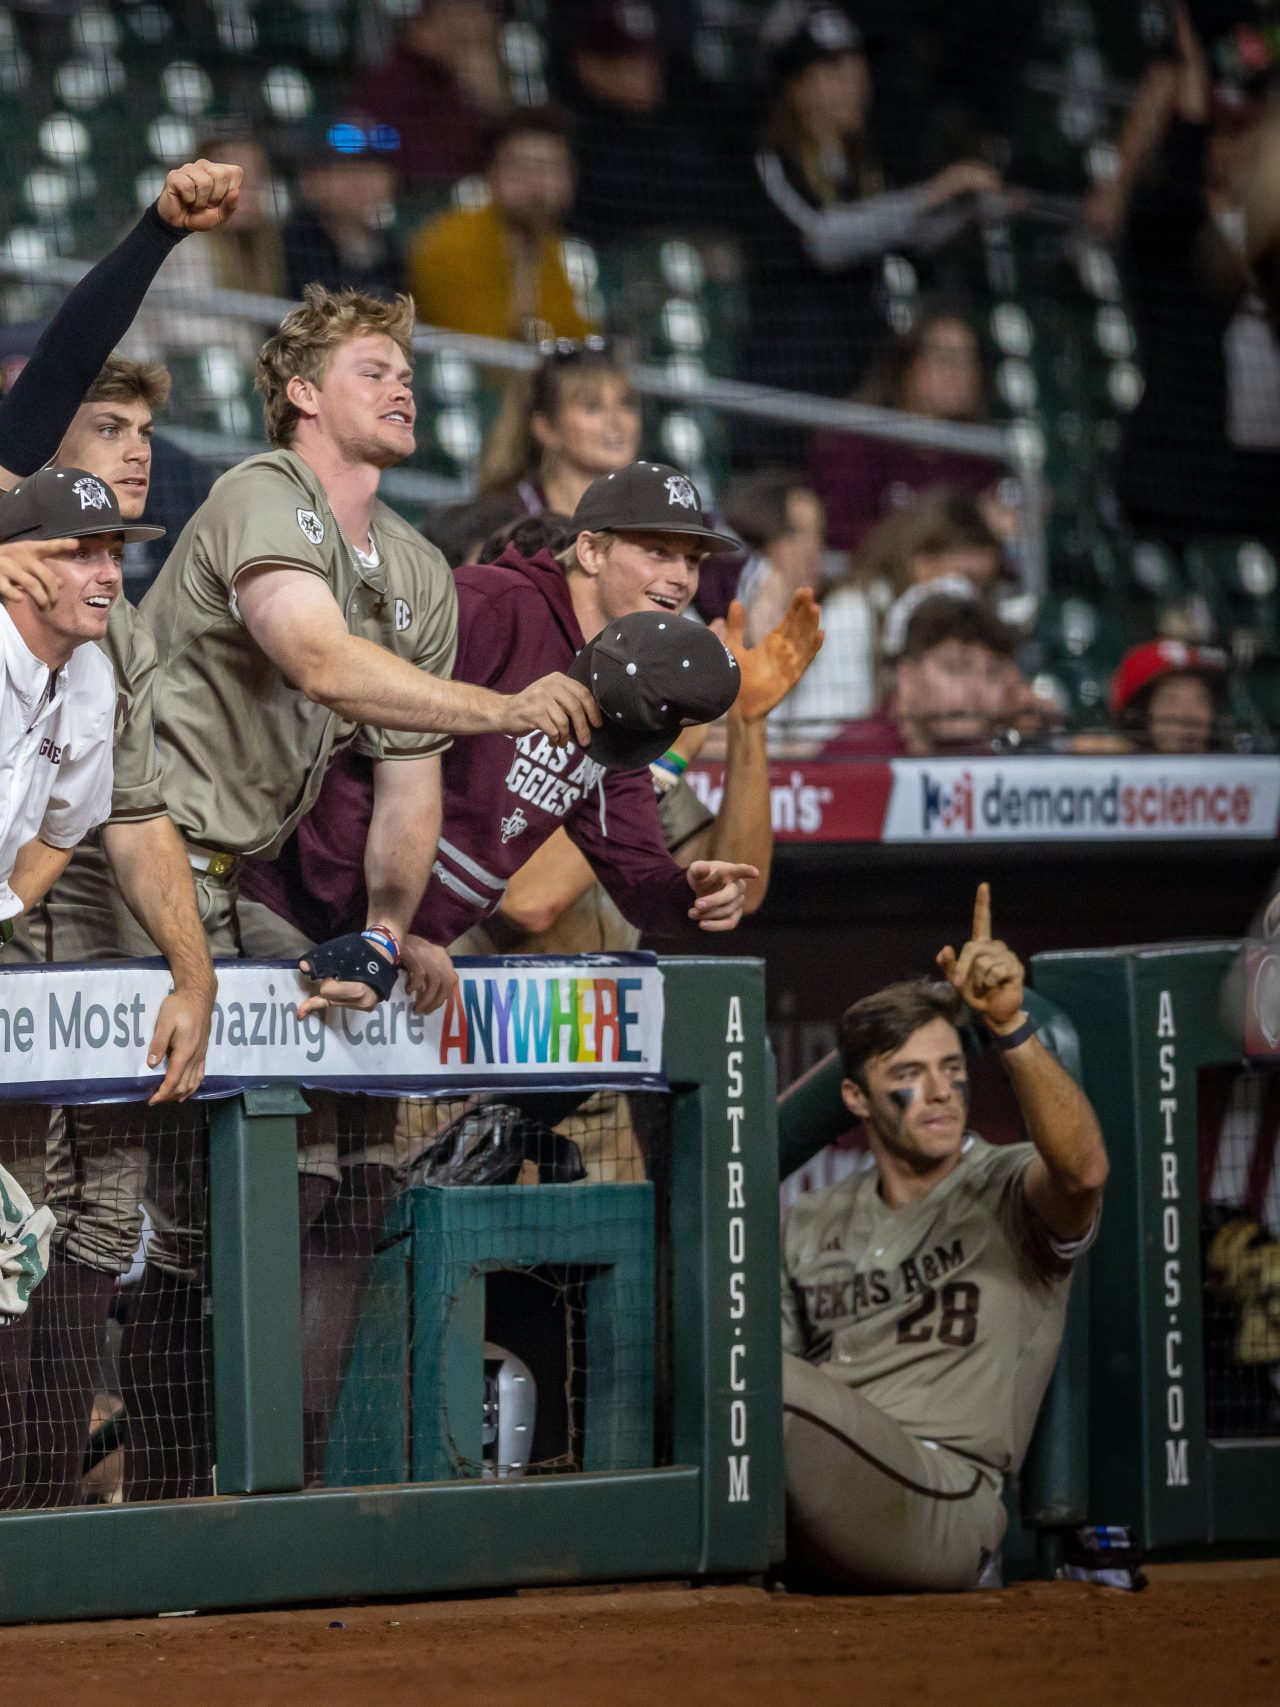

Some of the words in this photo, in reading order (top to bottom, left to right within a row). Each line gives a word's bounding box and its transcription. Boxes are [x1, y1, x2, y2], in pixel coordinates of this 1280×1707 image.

[394, 599, 412, 631] EC
[505, 757, 581, 817] GGIES
[982, 772, 1253, 827] demandscience
[49, 991, 146, 1050] Most
[169, 984, 325, 1063] azing
[440, 978, 642, 1064] ANYWHERE
[725, 996, 751, 1502] ASTROS.COM
[798, 1268, 891, 1319] TEXAS
[900, 1239, 964, 1294] A&M
[896, 1281, 980, 1347] 28
